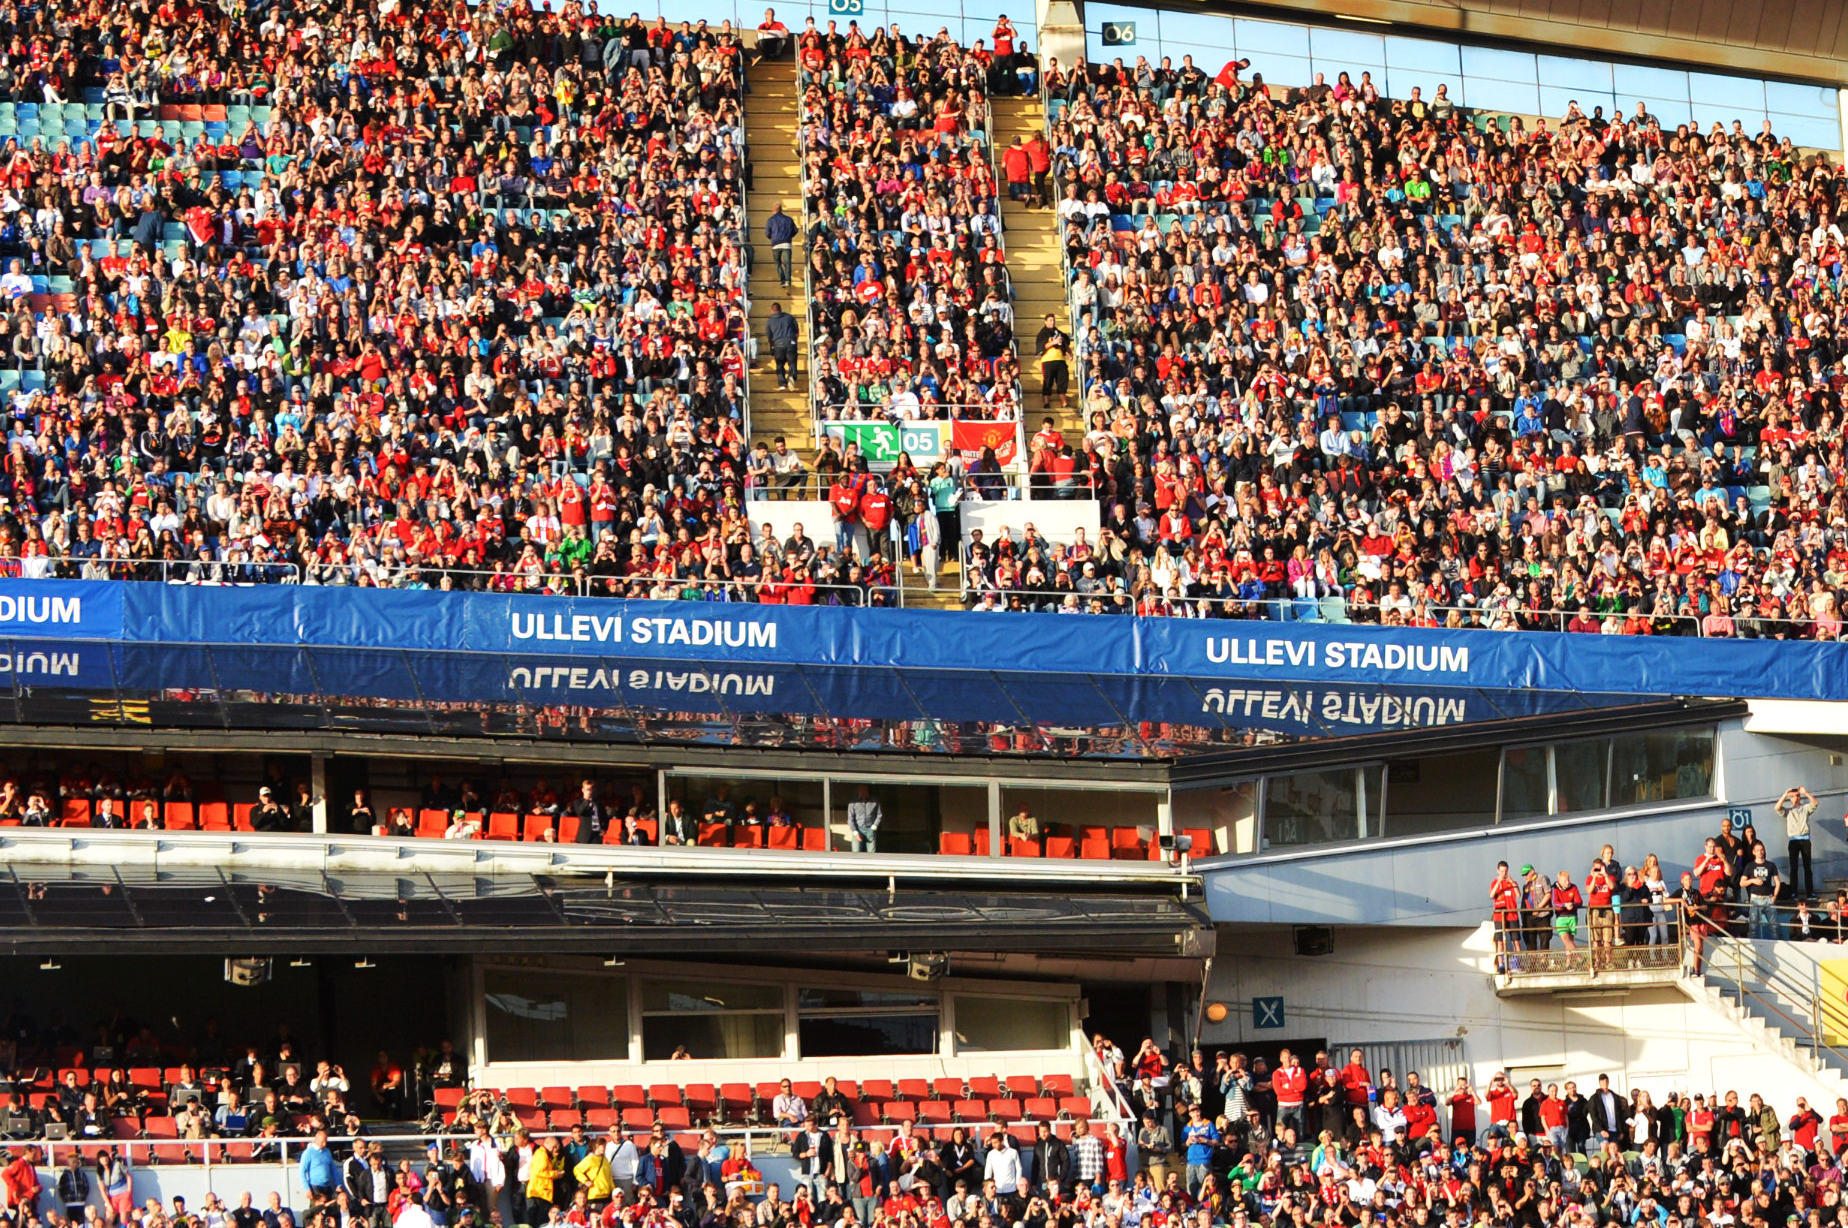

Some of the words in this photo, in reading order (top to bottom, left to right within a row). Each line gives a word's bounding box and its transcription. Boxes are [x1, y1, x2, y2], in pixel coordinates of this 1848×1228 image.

[511, 612, 622, 642] ULLEVI
[631, 617, 777, 648] STADIUM
[1206, 637, 1316, 667] ULLEVI
[1325, 641, 1469, 673] STADIUM
